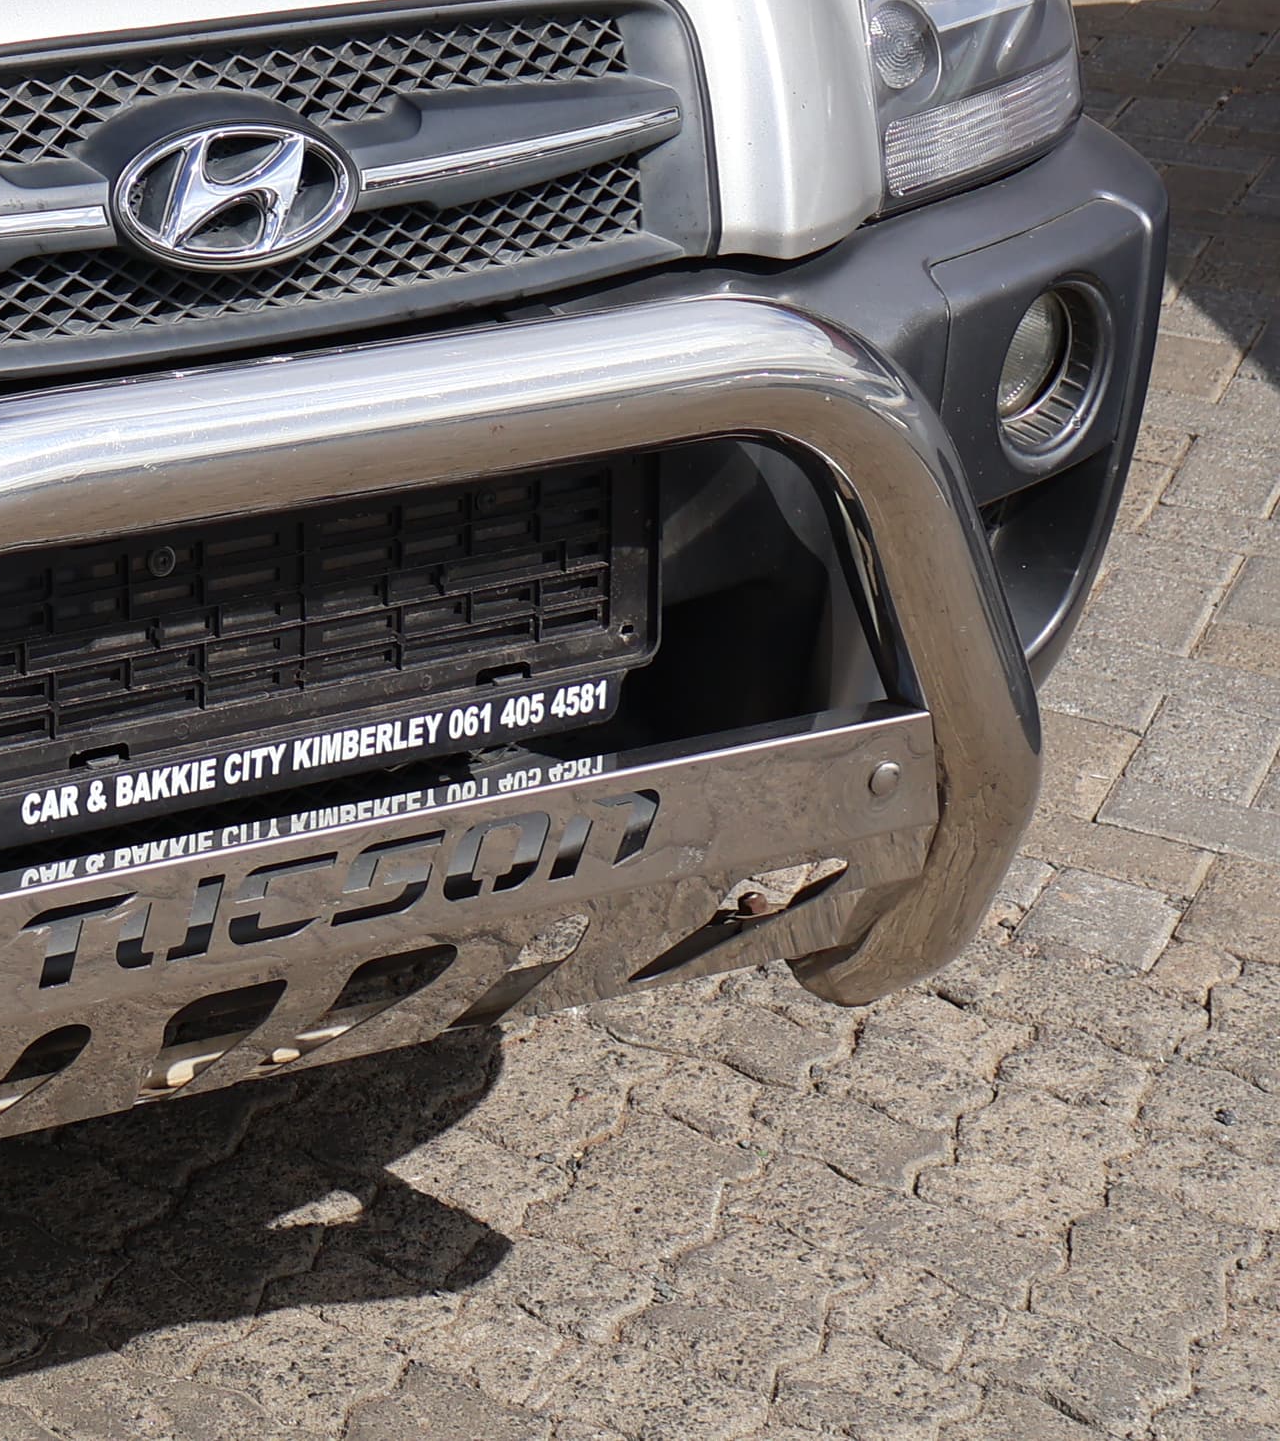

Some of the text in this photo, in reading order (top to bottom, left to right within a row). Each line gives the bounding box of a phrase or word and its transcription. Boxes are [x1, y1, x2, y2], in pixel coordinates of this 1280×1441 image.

[21, 680, 608, 826] CAR & BAKKIE CITY KIMBERLEY 061 405 4581
[20, 789, 661, 990] TUCSON
